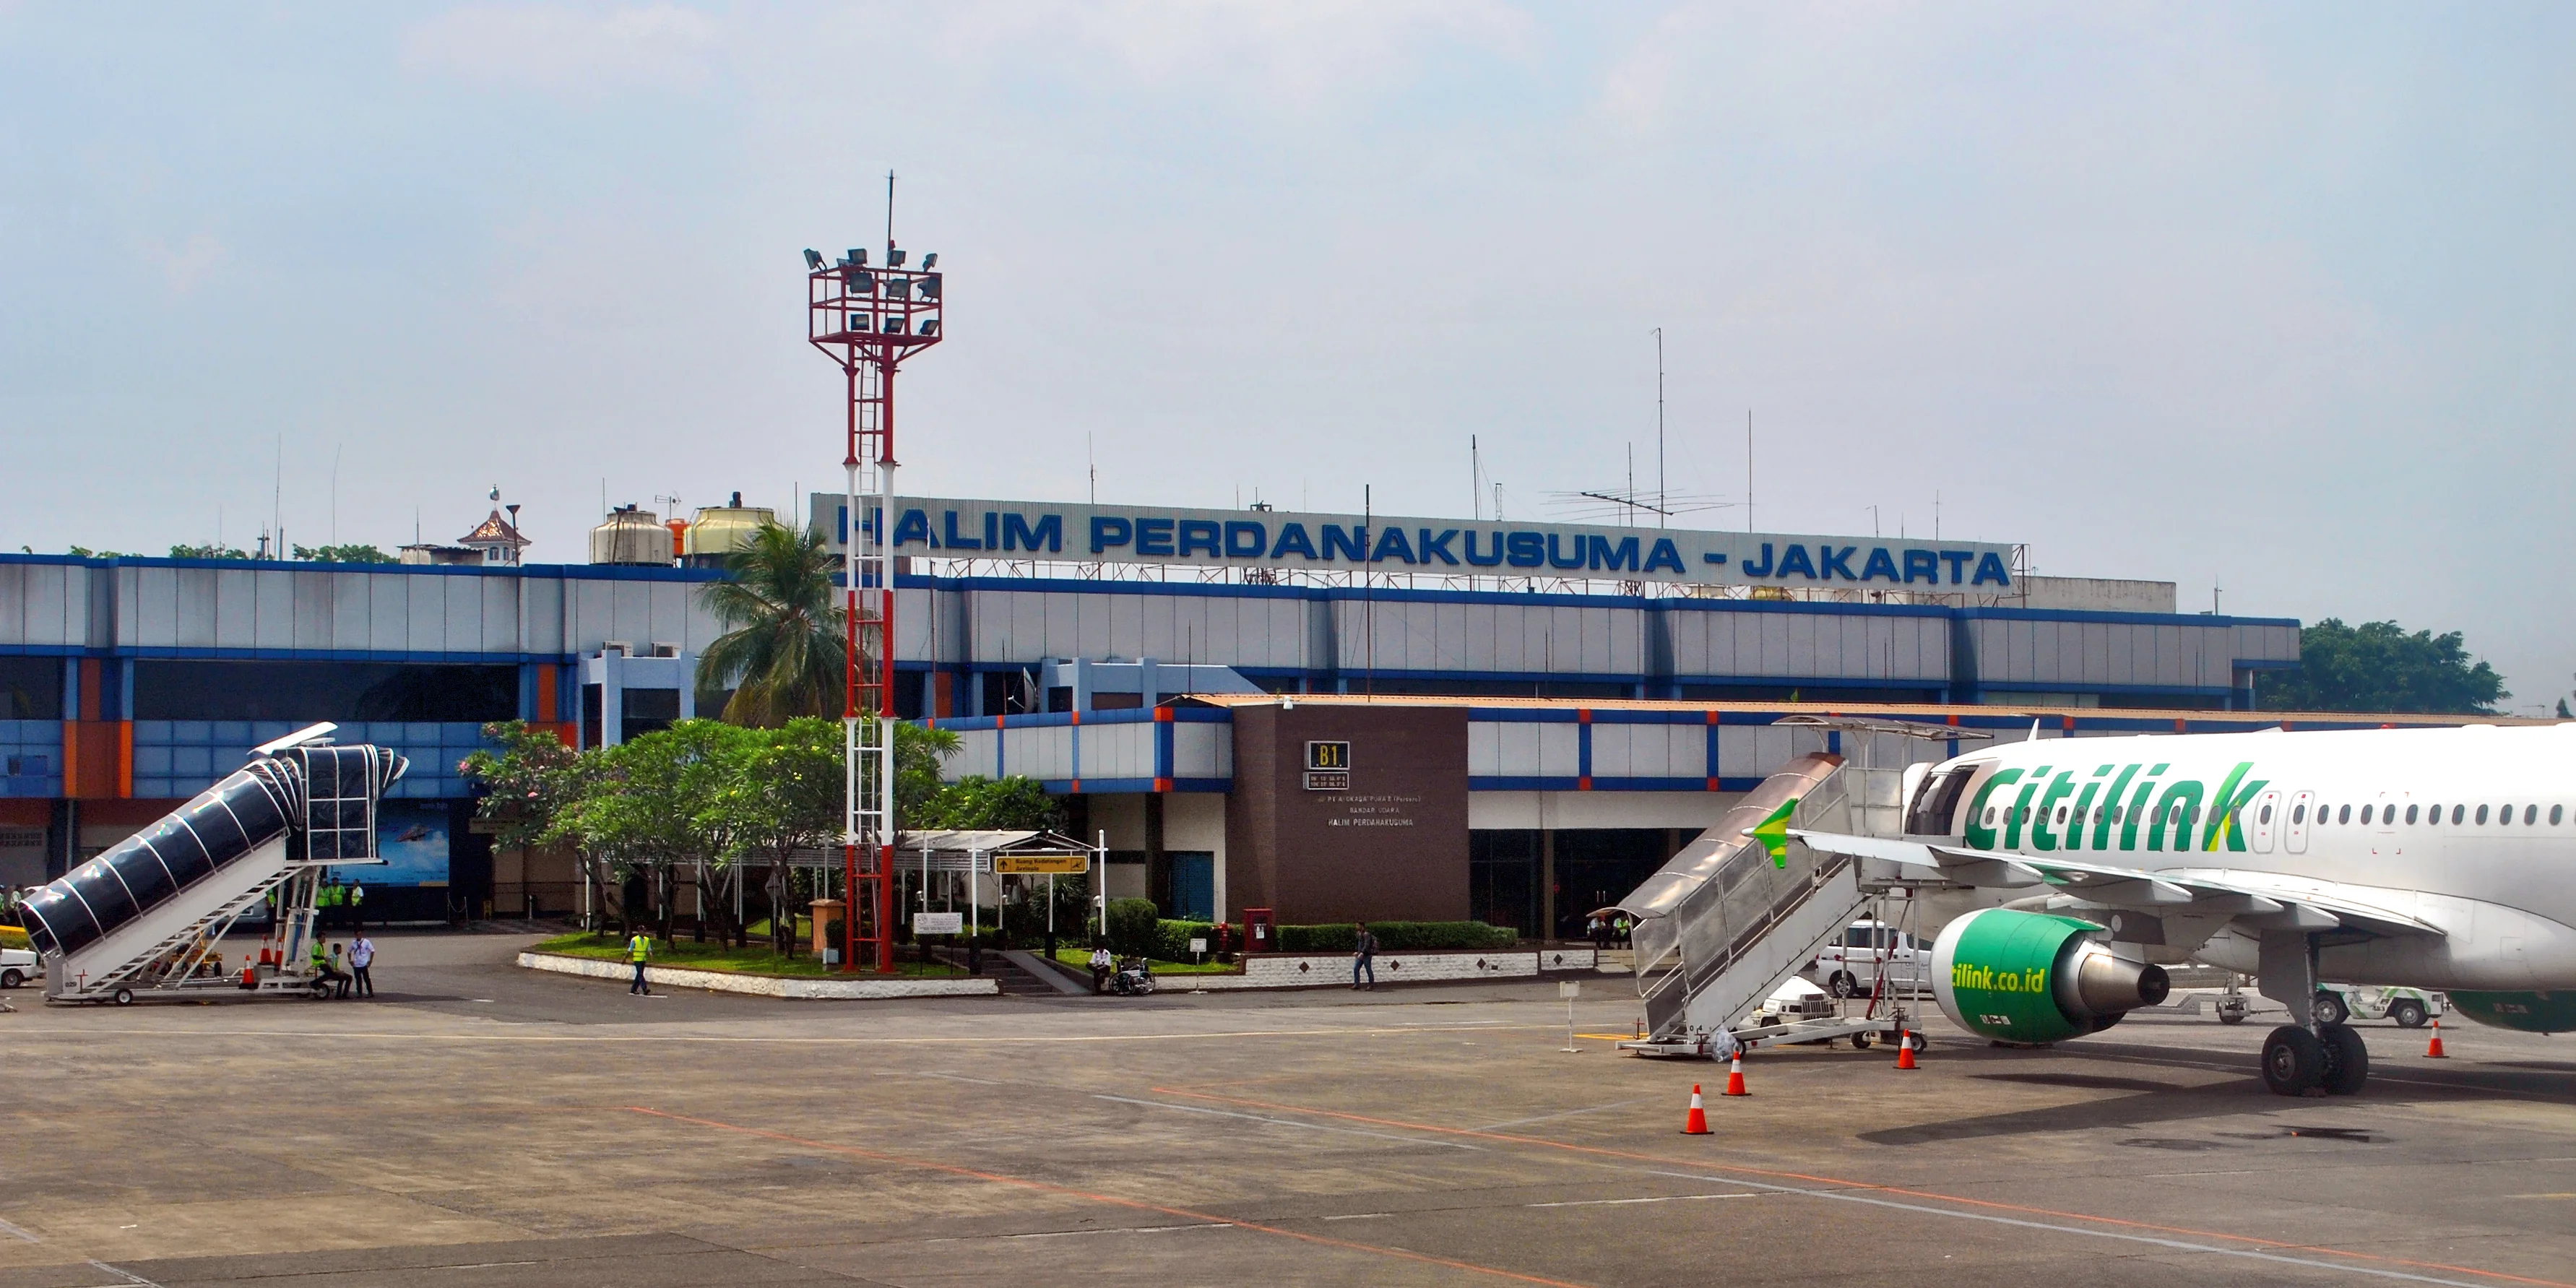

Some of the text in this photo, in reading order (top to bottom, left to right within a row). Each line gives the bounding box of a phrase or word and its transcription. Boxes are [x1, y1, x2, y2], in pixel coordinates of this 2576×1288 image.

[839, 505, 1062, 553] HALIM
[1091, 517, 1686, 574] PERDANAKUSUMA
[1742, 543, 2010, 587] JAKARTA
[1320, 745, 1337, 766] B1
[1964, 762, 2270, 852] Citilink
